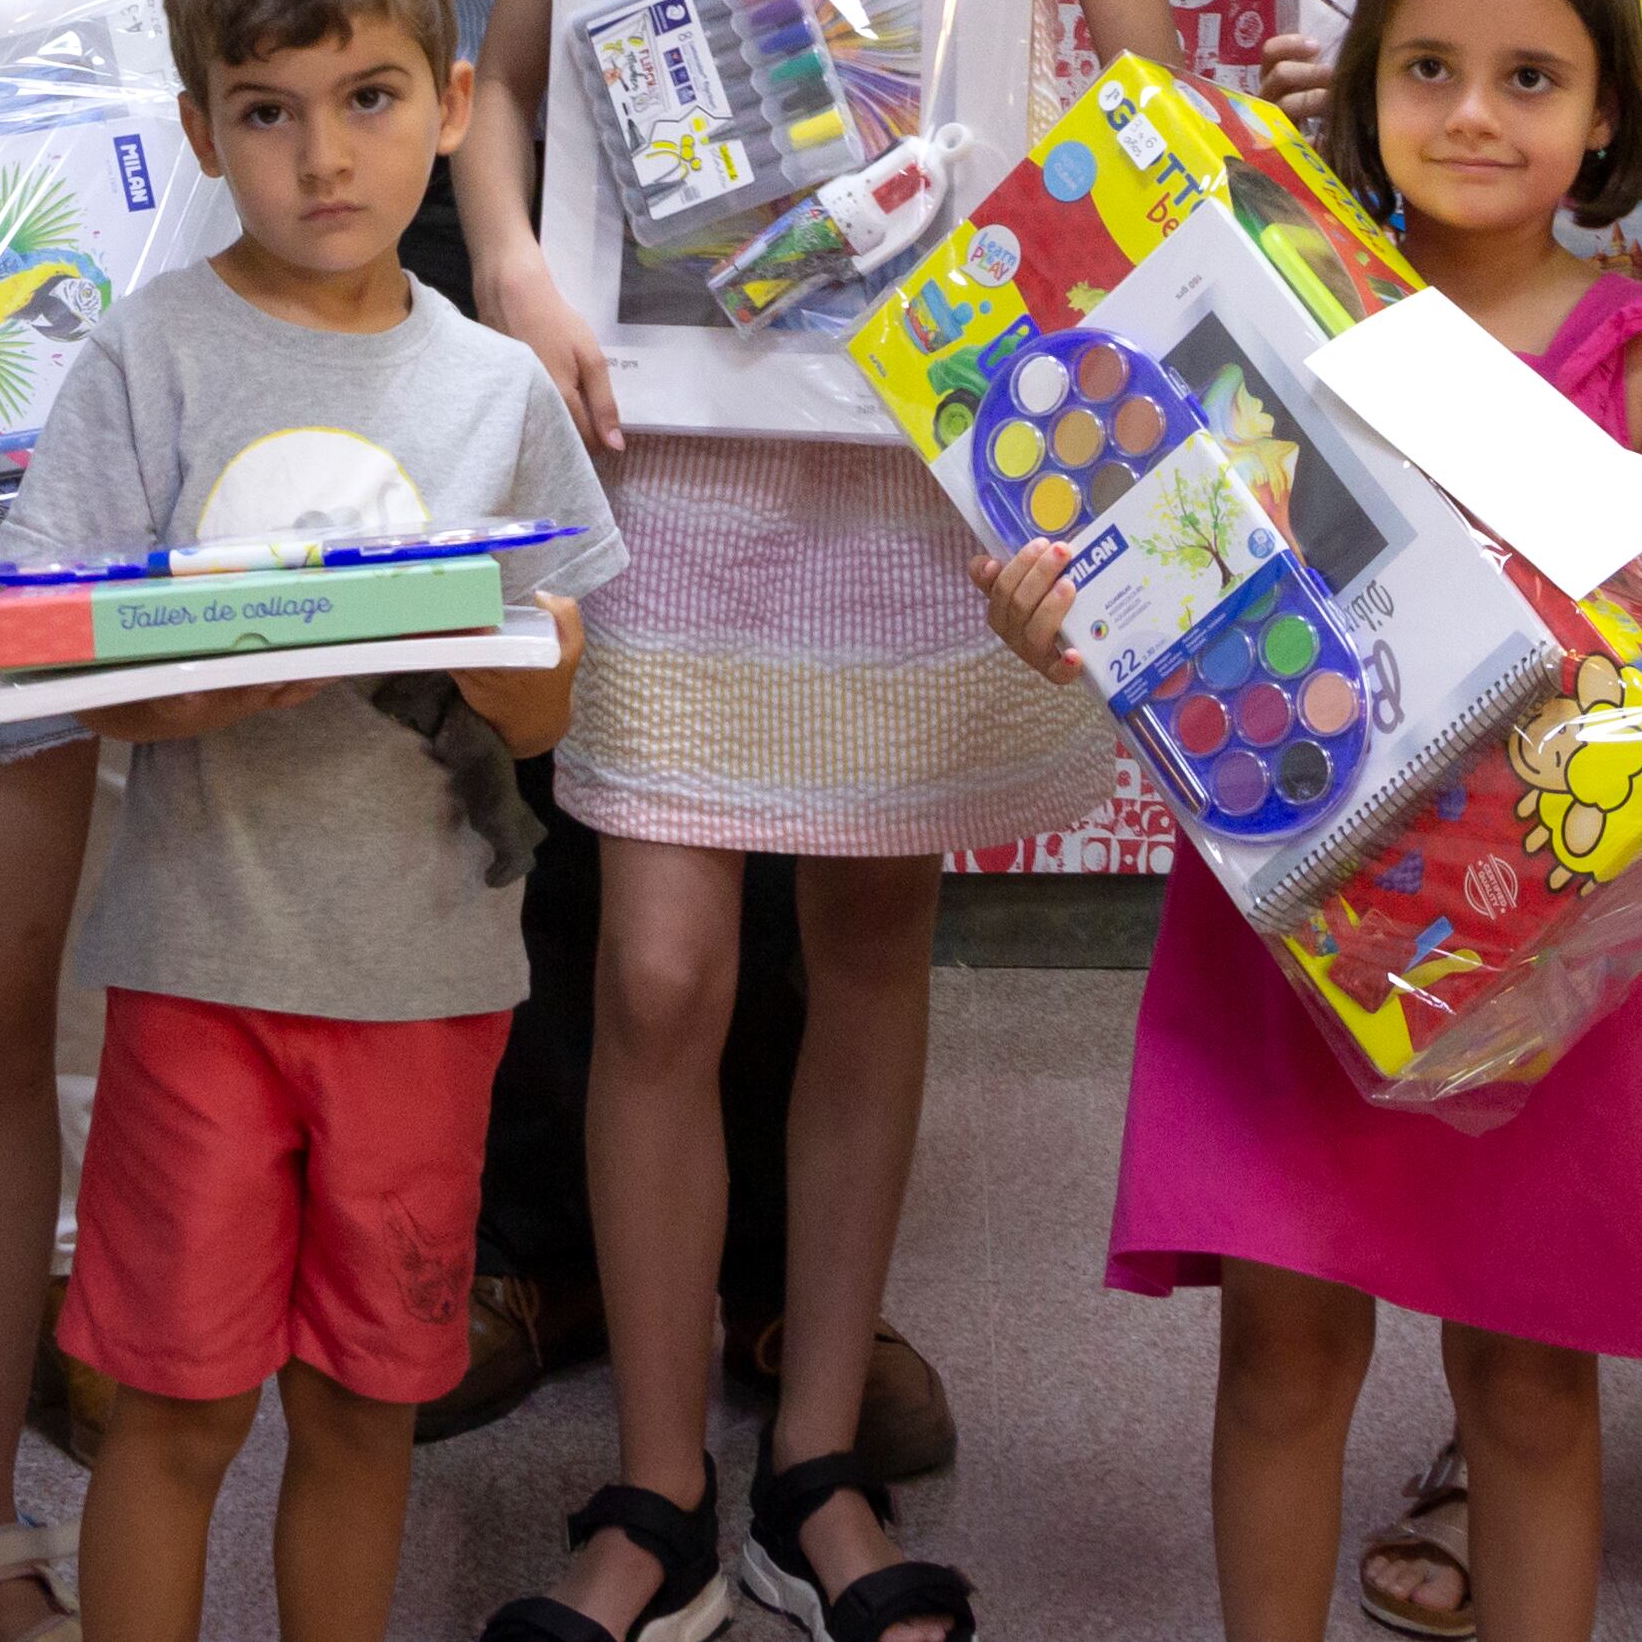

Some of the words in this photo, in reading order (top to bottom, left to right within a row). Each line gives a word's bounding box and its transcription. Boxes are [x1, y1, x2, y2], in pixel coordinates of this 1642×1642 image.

[120, 144, 148, 203] MILAN
[970, 246, 1010, 281] PLAY
[978, 233, 1017, 266] Learn
[1069, 536, 1118, 583] MILAN
[119, 600, 197, 630] Taller
[204, 597, 235, 622] de
[243, 594, 332, 625] collage
[1110, 649, 1141, 683] 22
[1477, 870, 1499, 907] QUALITY
[1482, 862, 1507, 908] CERTIFIED
